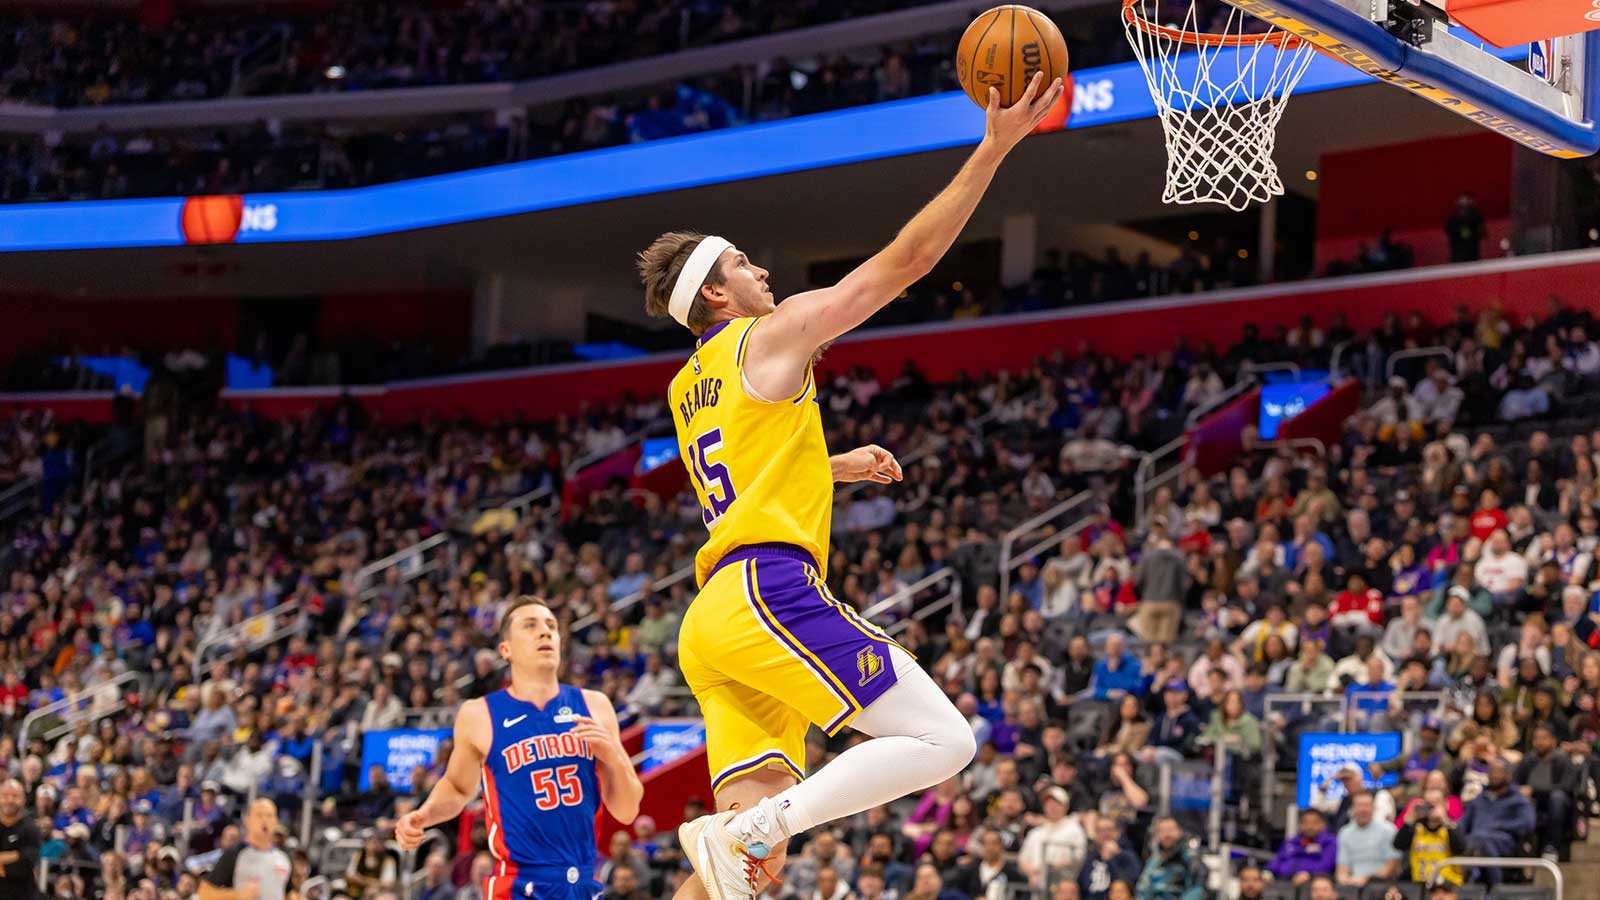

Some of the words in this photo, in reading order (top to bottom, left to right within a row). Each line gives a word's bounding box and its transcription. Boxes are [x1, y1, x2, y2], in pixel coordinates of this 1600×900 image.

[679, 377, 723, 428] REAVES
[687, 426, 737, 528] 15
[530, 764, 583, 811] 55
